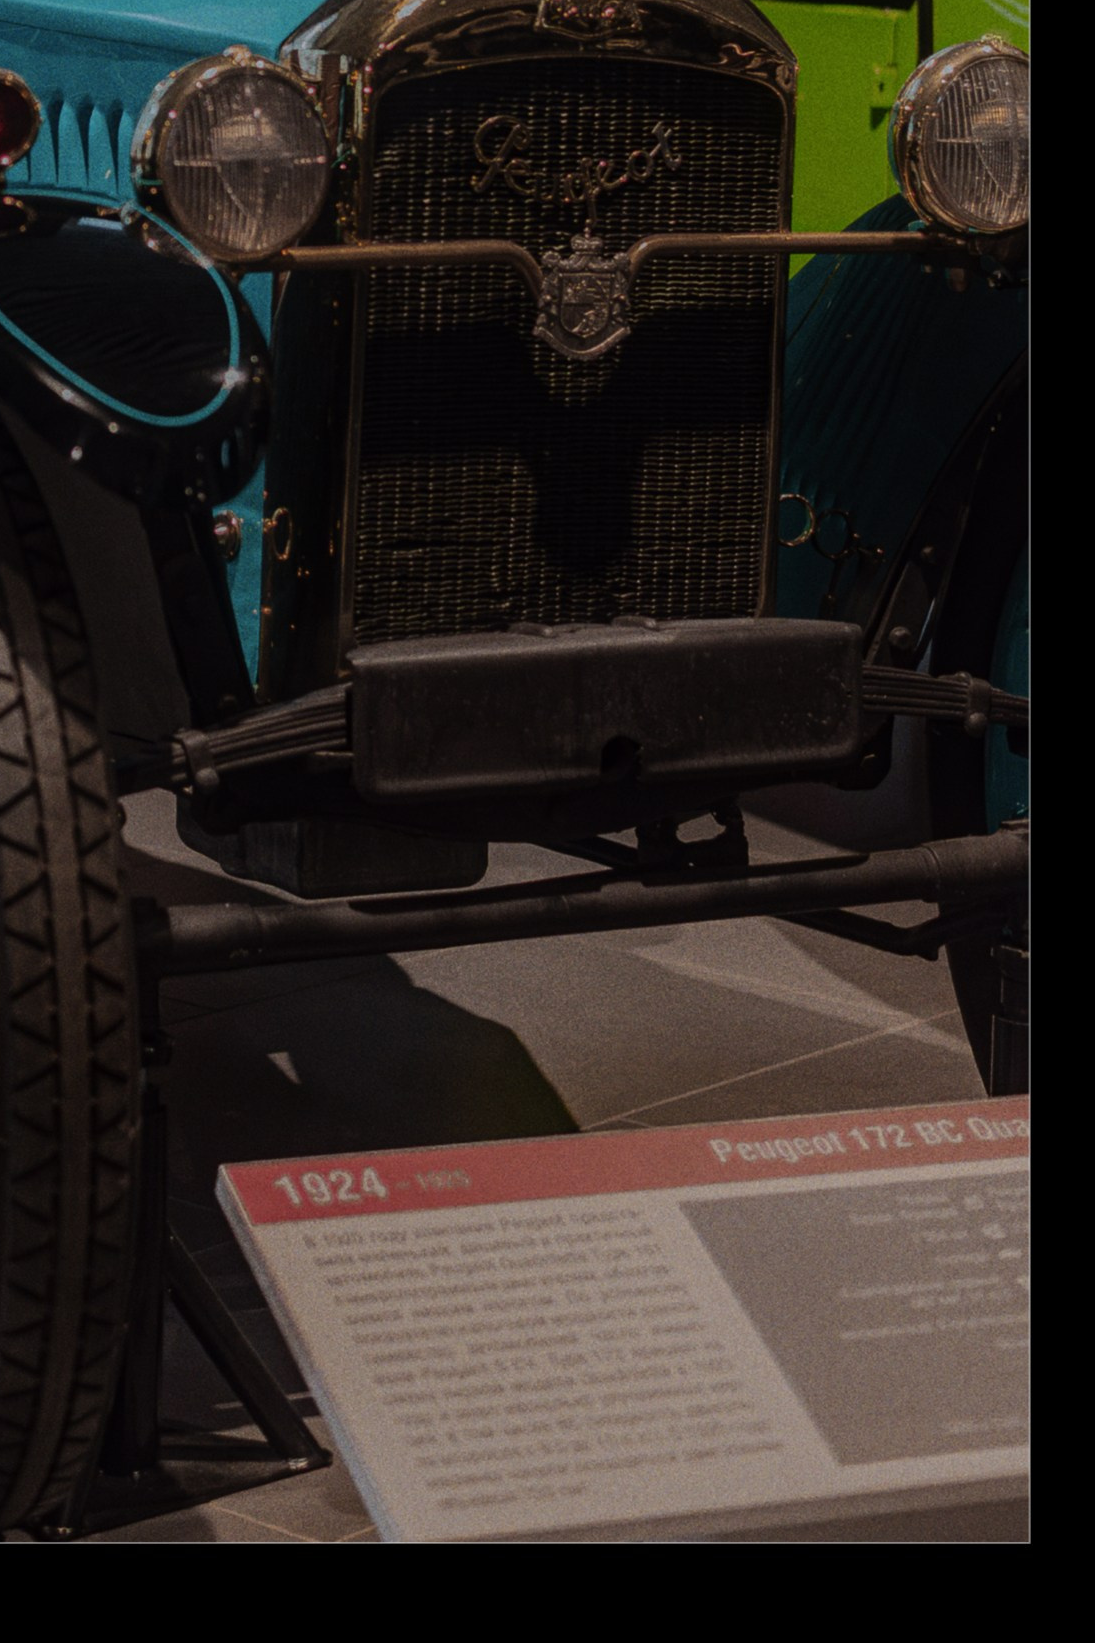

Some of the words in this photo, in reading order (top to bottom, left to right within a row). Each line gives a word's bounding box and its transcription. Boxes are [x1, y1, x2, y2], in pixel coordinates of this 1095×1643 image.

[469, 114, 682, 226] Peugeot
[709, 1130, 848, 1164] Peugeot
[848, 1124, 914, 1151] 172
[914, 1119, 963, 1146] BC
[274, 1166, 388, 1207] 1924
